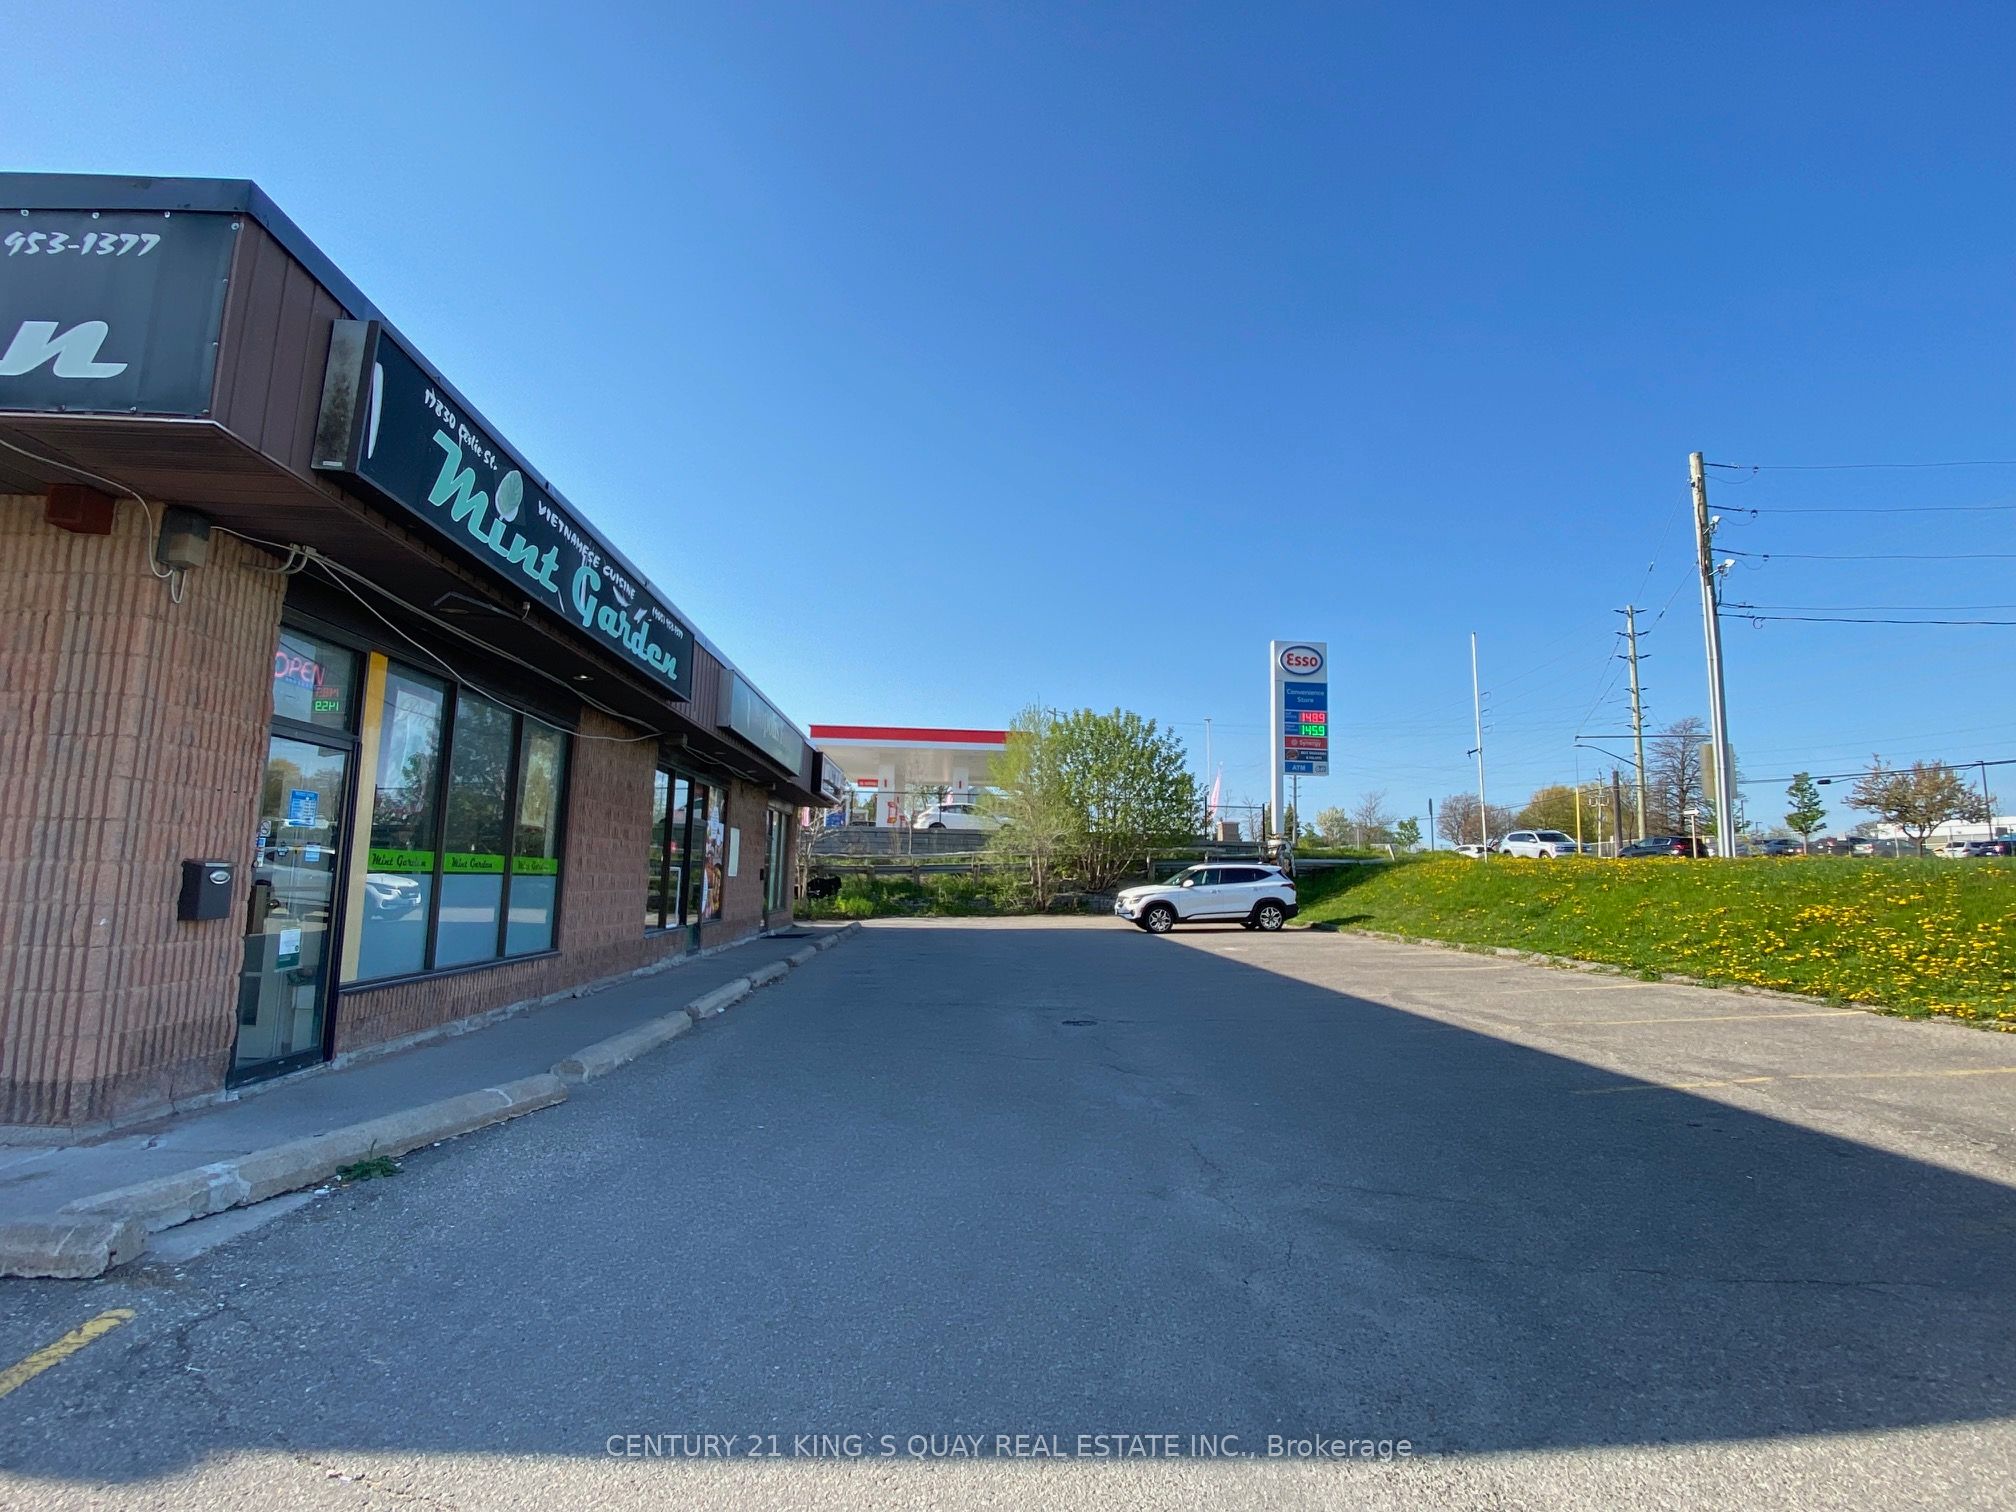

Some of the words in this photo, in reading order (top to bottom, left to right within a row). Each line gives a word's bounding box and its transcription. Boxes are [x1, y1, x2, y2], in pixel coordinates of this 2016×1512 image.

[4, 231, 161, 257] 953-1377
[483, 450, 498, 471] St.
[428, 428, 559, 593] Mint
[538, 499, 601, 568] VIETNAMESE
[602, 565, 636, 600] CUISINE
[572, 565, 678, 681] Garden
[274, 651, 325, 687] OPEN
[1286, 653, 1318, 667] Esso
[372, 853, 394, 866] Mint
[451, 857, 468, 868] Mint
[469, 858, 493, 869] Garden
